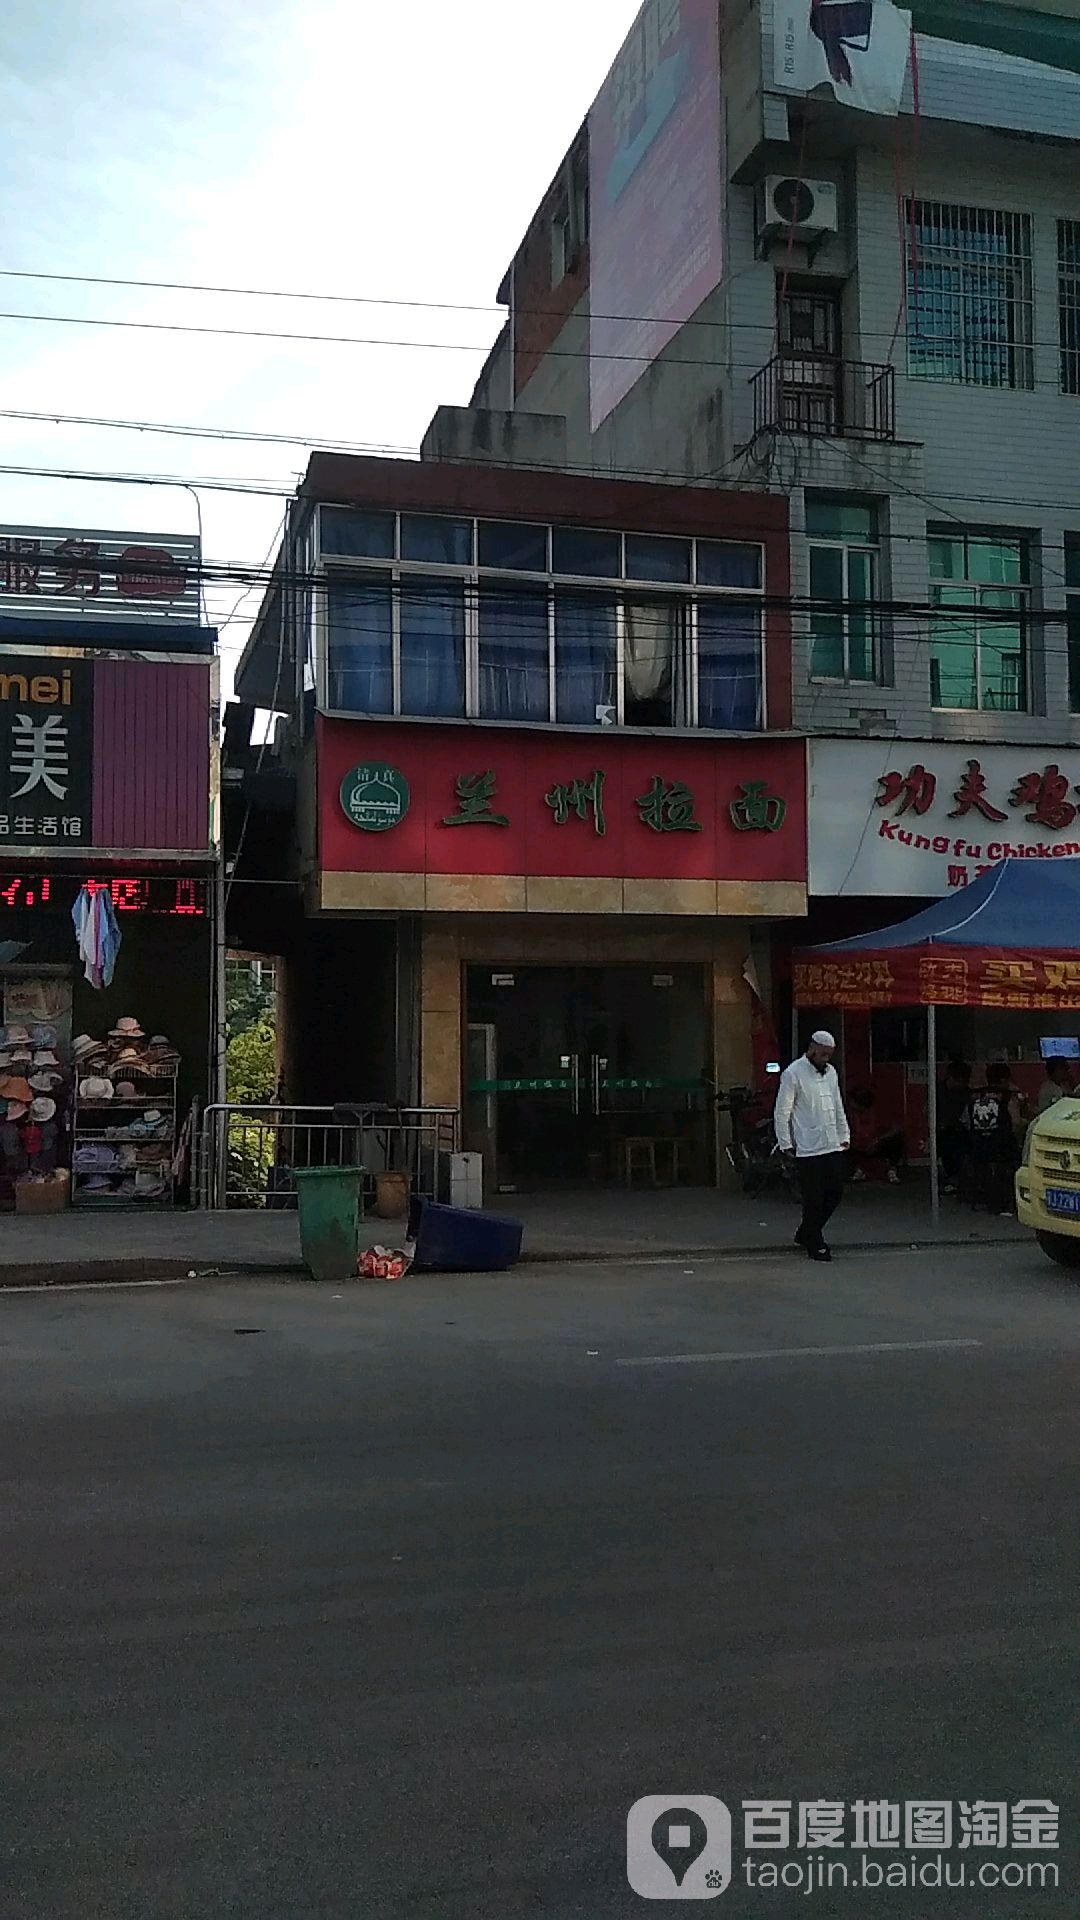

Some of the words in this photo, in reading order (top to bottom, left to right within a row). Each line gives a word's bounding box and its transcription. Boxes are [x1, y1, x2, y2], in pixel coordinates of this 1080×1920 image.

[9, 713, 69, 800] 美
[441, 768, 787, 836] 兰州拉面
[875, 758, 1080, 830] 功夫鸡
[987, 842, 1080, 861] Chicken
